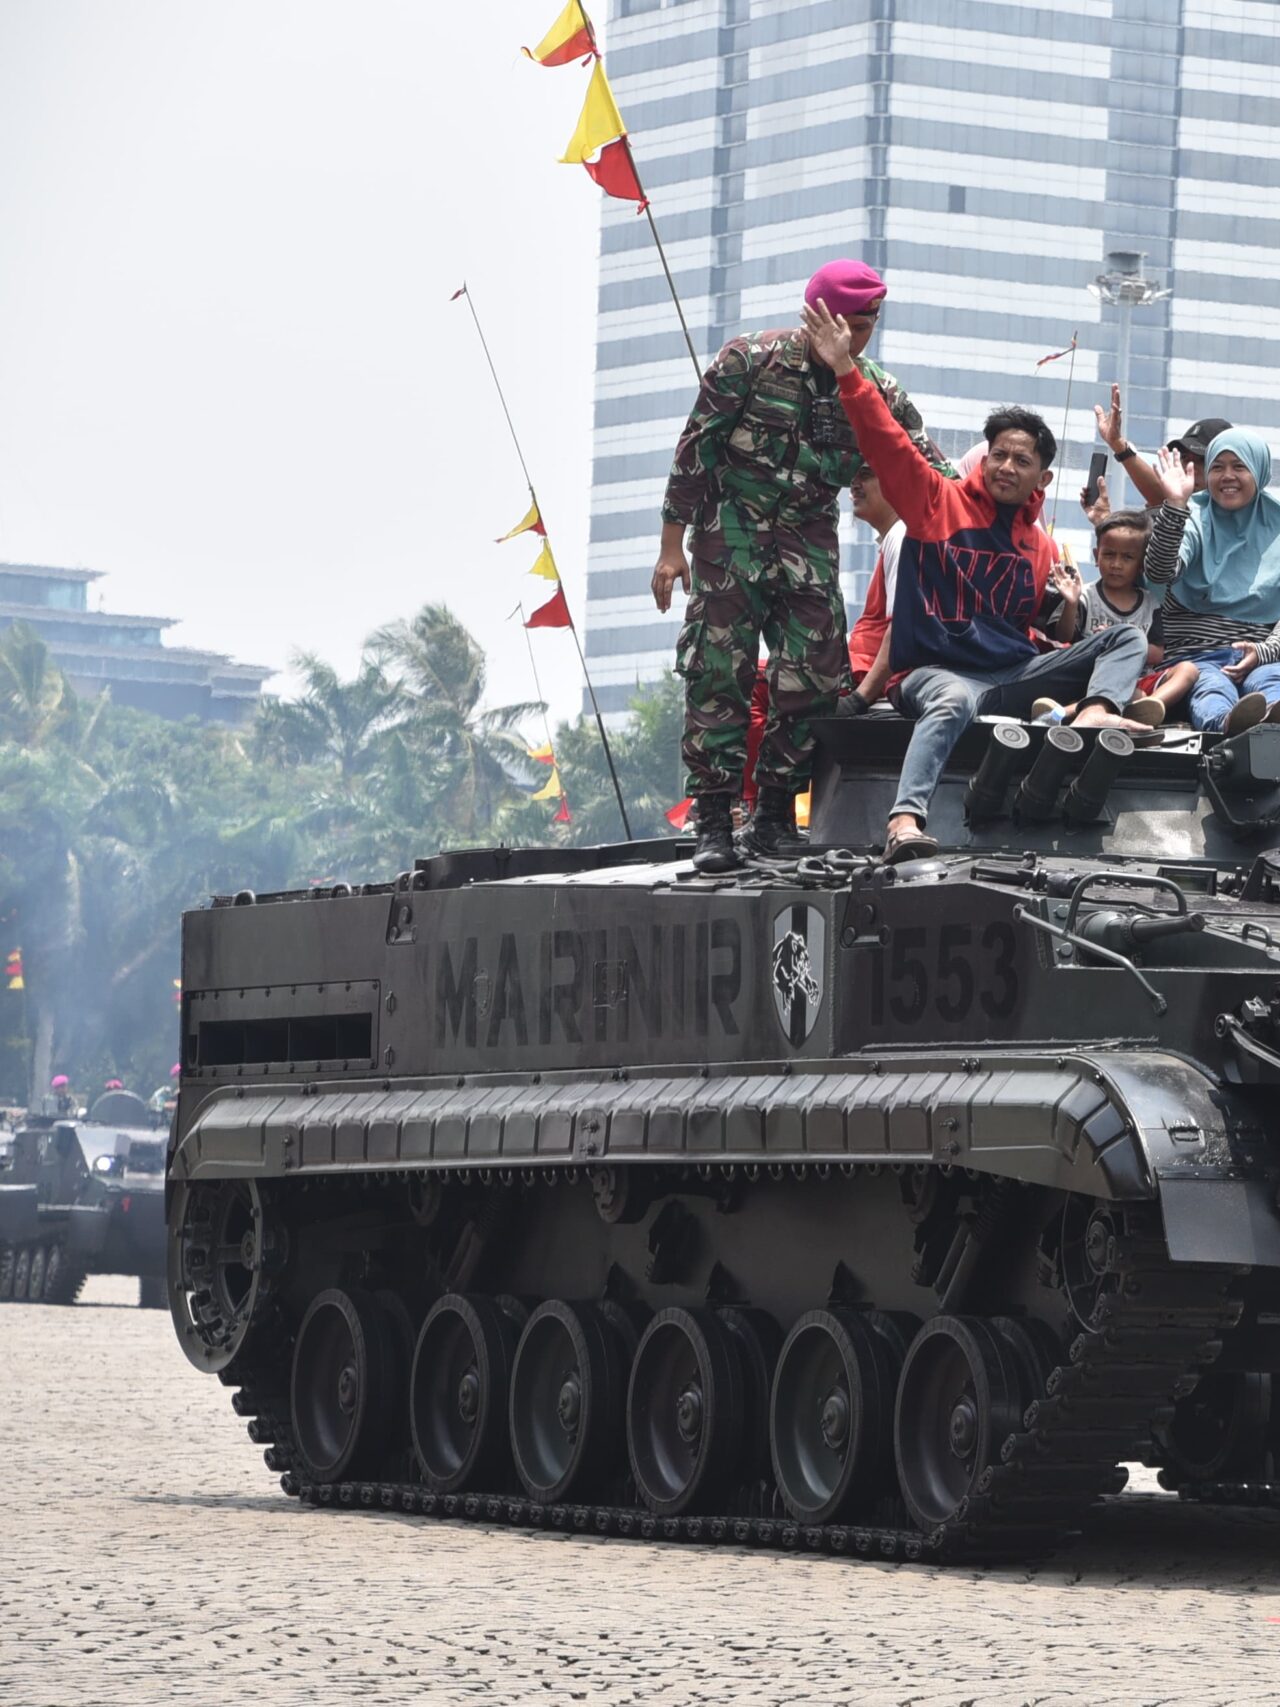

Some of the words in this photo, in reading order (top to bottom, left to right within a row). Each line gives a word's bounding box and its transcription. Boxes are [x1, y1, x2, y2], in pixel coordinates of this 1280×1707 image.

[919, 539, 1036, 622] NIKE
[434, 917, 742, 1049] MARINIR
[867, 920, 1019, 1026] 1553
